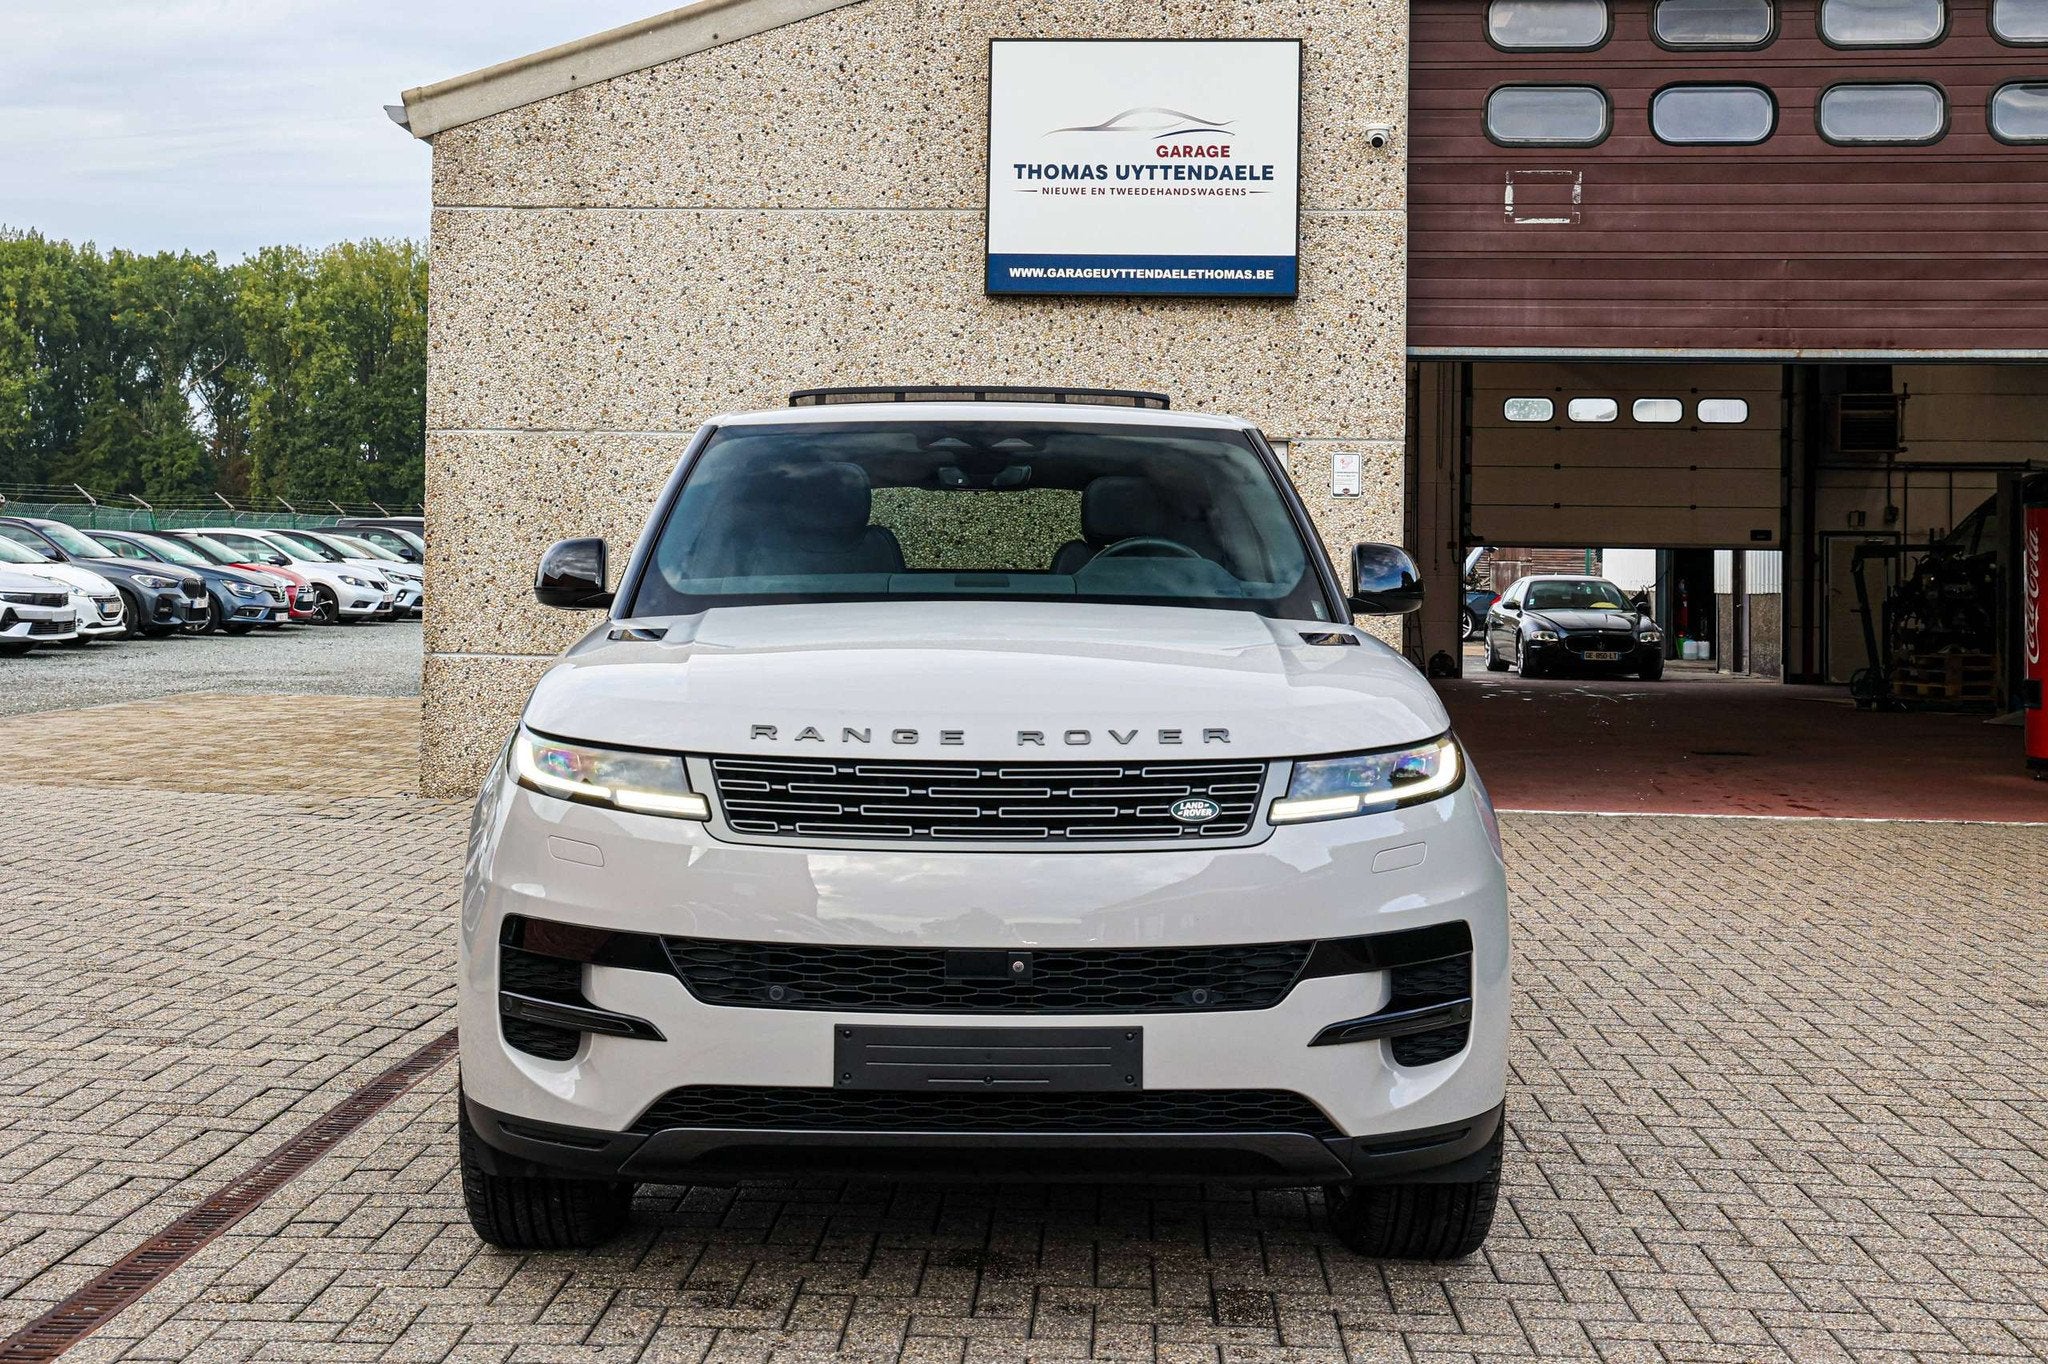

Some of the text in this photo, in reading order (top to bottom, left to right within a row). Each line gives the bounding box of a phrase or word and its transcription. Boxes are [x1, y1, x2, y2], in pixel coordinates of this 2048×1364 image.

[1156, 145, 1231, 158] GARAGE
[1013, 163, 1275, 181] THOMAS UYTTENDAELE
[1042, 187, 1247, 196] NIEUWE EN TWEEDEHANDSWAGENS
[1009, 267, 1275, 280] WWW.GARAGEUYTTENDAELETHOMAS.BE
[750, 724, 1232, 746] RANGE ROVER
